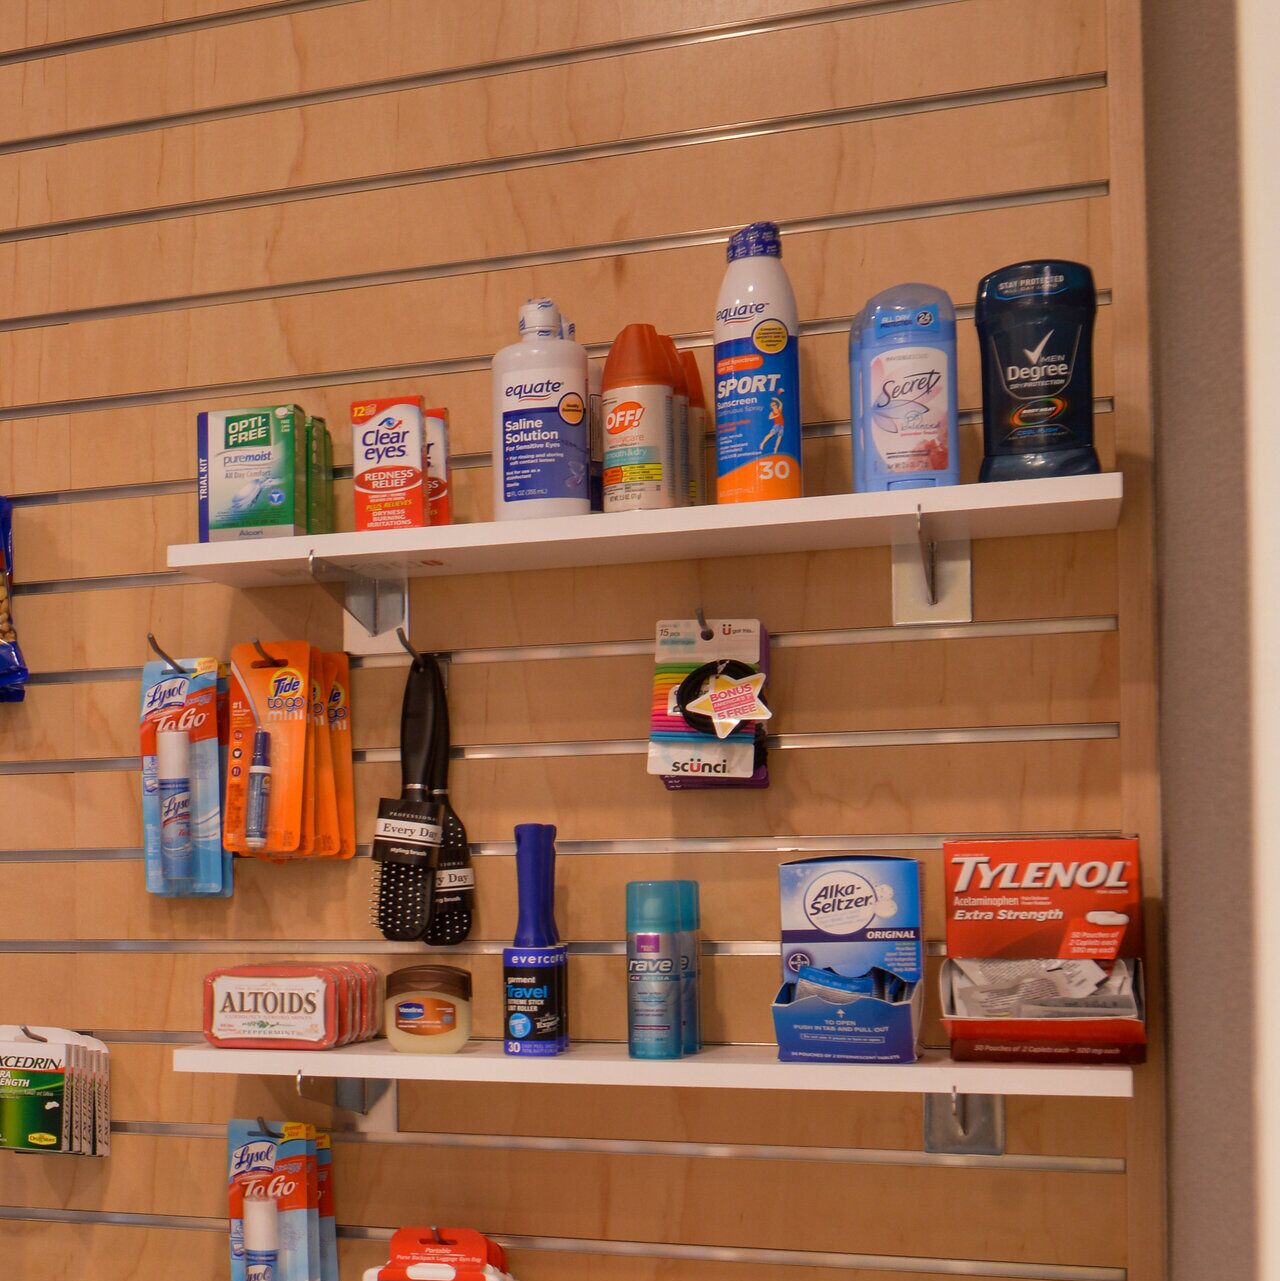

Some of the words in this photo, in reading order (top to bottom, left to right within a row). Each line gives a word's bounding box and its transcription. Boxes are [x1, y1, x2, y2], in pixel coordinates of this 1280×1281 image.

[715, 303, 766, 321] equate
[1006, 362, 1070, 383] Degree
[504, 379, 562, 399] equate
[717, 373, 782, 400] SPORT
[876, 369, 942, 408] Secret
[352, 405, 365, 418] 12
[717, 396, 758, 410] Sunscreen
[226, 414, 268, 435] OPTI-
[504, 417, 544, 433] Saline
[606, 406, 647, 431] OFF!
[228, 427, 269, 447] FREE
[361, 427, 410, 448] Clear
[505, 430, 559, 444] Solution
[223, 450, 272, 468] puremoist
[363, 468, 414, 483] REDNESS
[758, 460, 791, 480] 30
[199, 477, 208, 501] TRIAL
[371, 477, 408, 490] RELIEF
[658, 627, 670, 638] 15
[146, 680, 186, 707] Lysol
[272, 676, 302, 698] Tide
[710, 683, 753, 702] BONUS
[284, 697, 305, 713] go
[717, 708, 727, 721] 5
[726, 703, 758, 719] FREE
[178, 707, 208, 732] Go
[672, 757, 727, 774] scünci
[383, 823, 417, 841] Every
[448, 873, 469, 884] Day
[951, 856, 1128, 893] TYLENOL
[813, 883, 862, 902] Alka-
[809, 894, 873, 916] Seltzer
[953, 909, 995, 921] Extra
[996, 908, 1064, 923] Strength
[866, 930, 916, 940] ORIGINAL
[628, 958, 673, 974] rave
[506, 984, 549, 999] Travel
[219, 990, 318, 1016] ALTOIDS
[507, 1042, 521, 1054] 30
[234, 1144, 274, 1170] Lysol
[267, 1175, 296, 1197] Go
